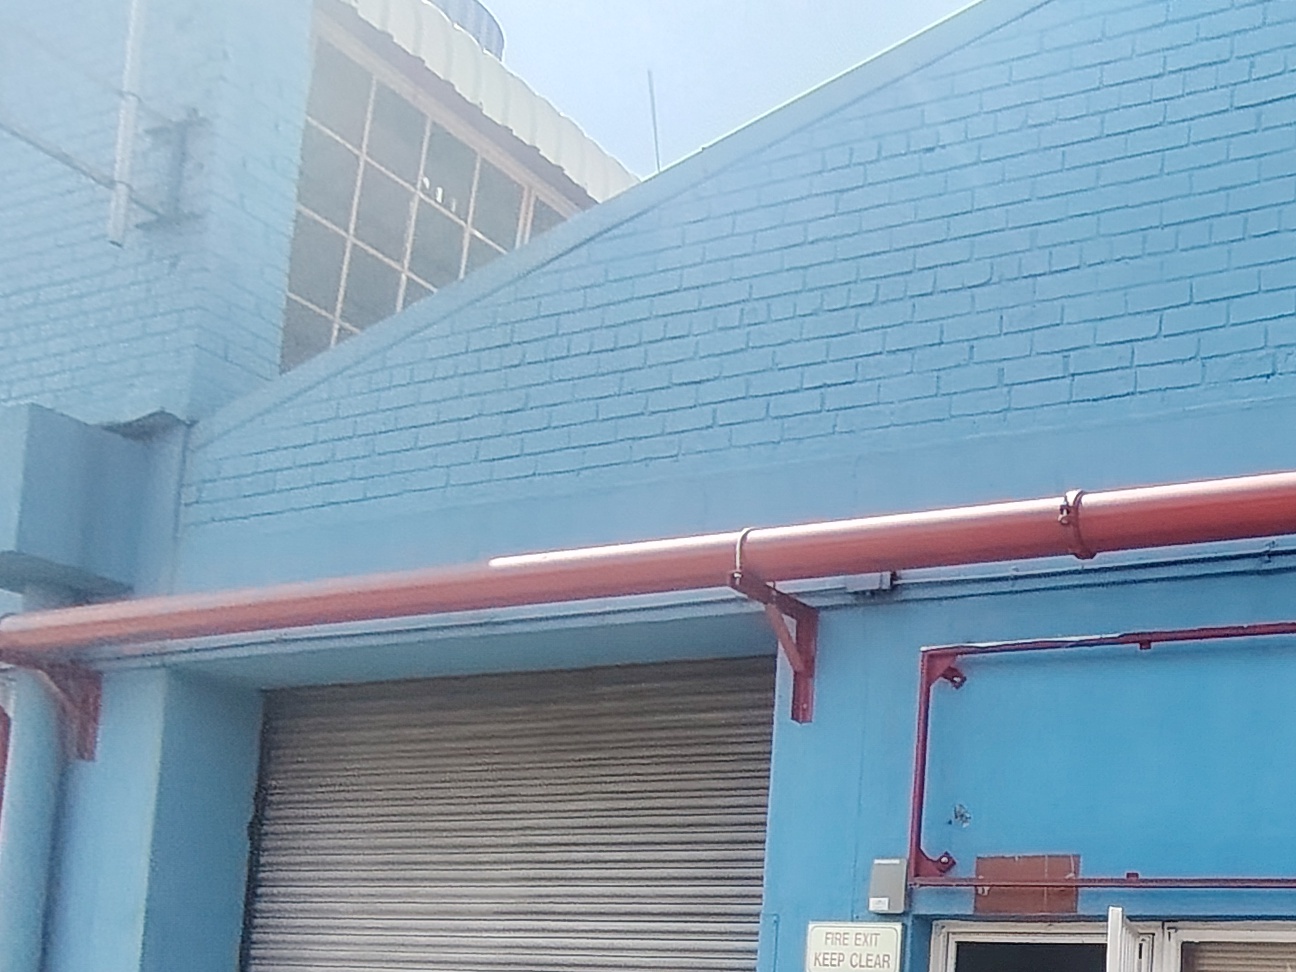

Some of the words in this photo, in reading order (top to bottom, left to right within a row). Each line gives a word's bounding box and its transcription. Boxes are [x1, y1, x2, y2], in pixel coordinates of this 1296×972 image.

[824, 931, 850, 946] FIRE
[854, 932, 881, 947] EXIT
[813, 952, 845, 967] KEEP
[849, 953, 891, 969] CLEAR
